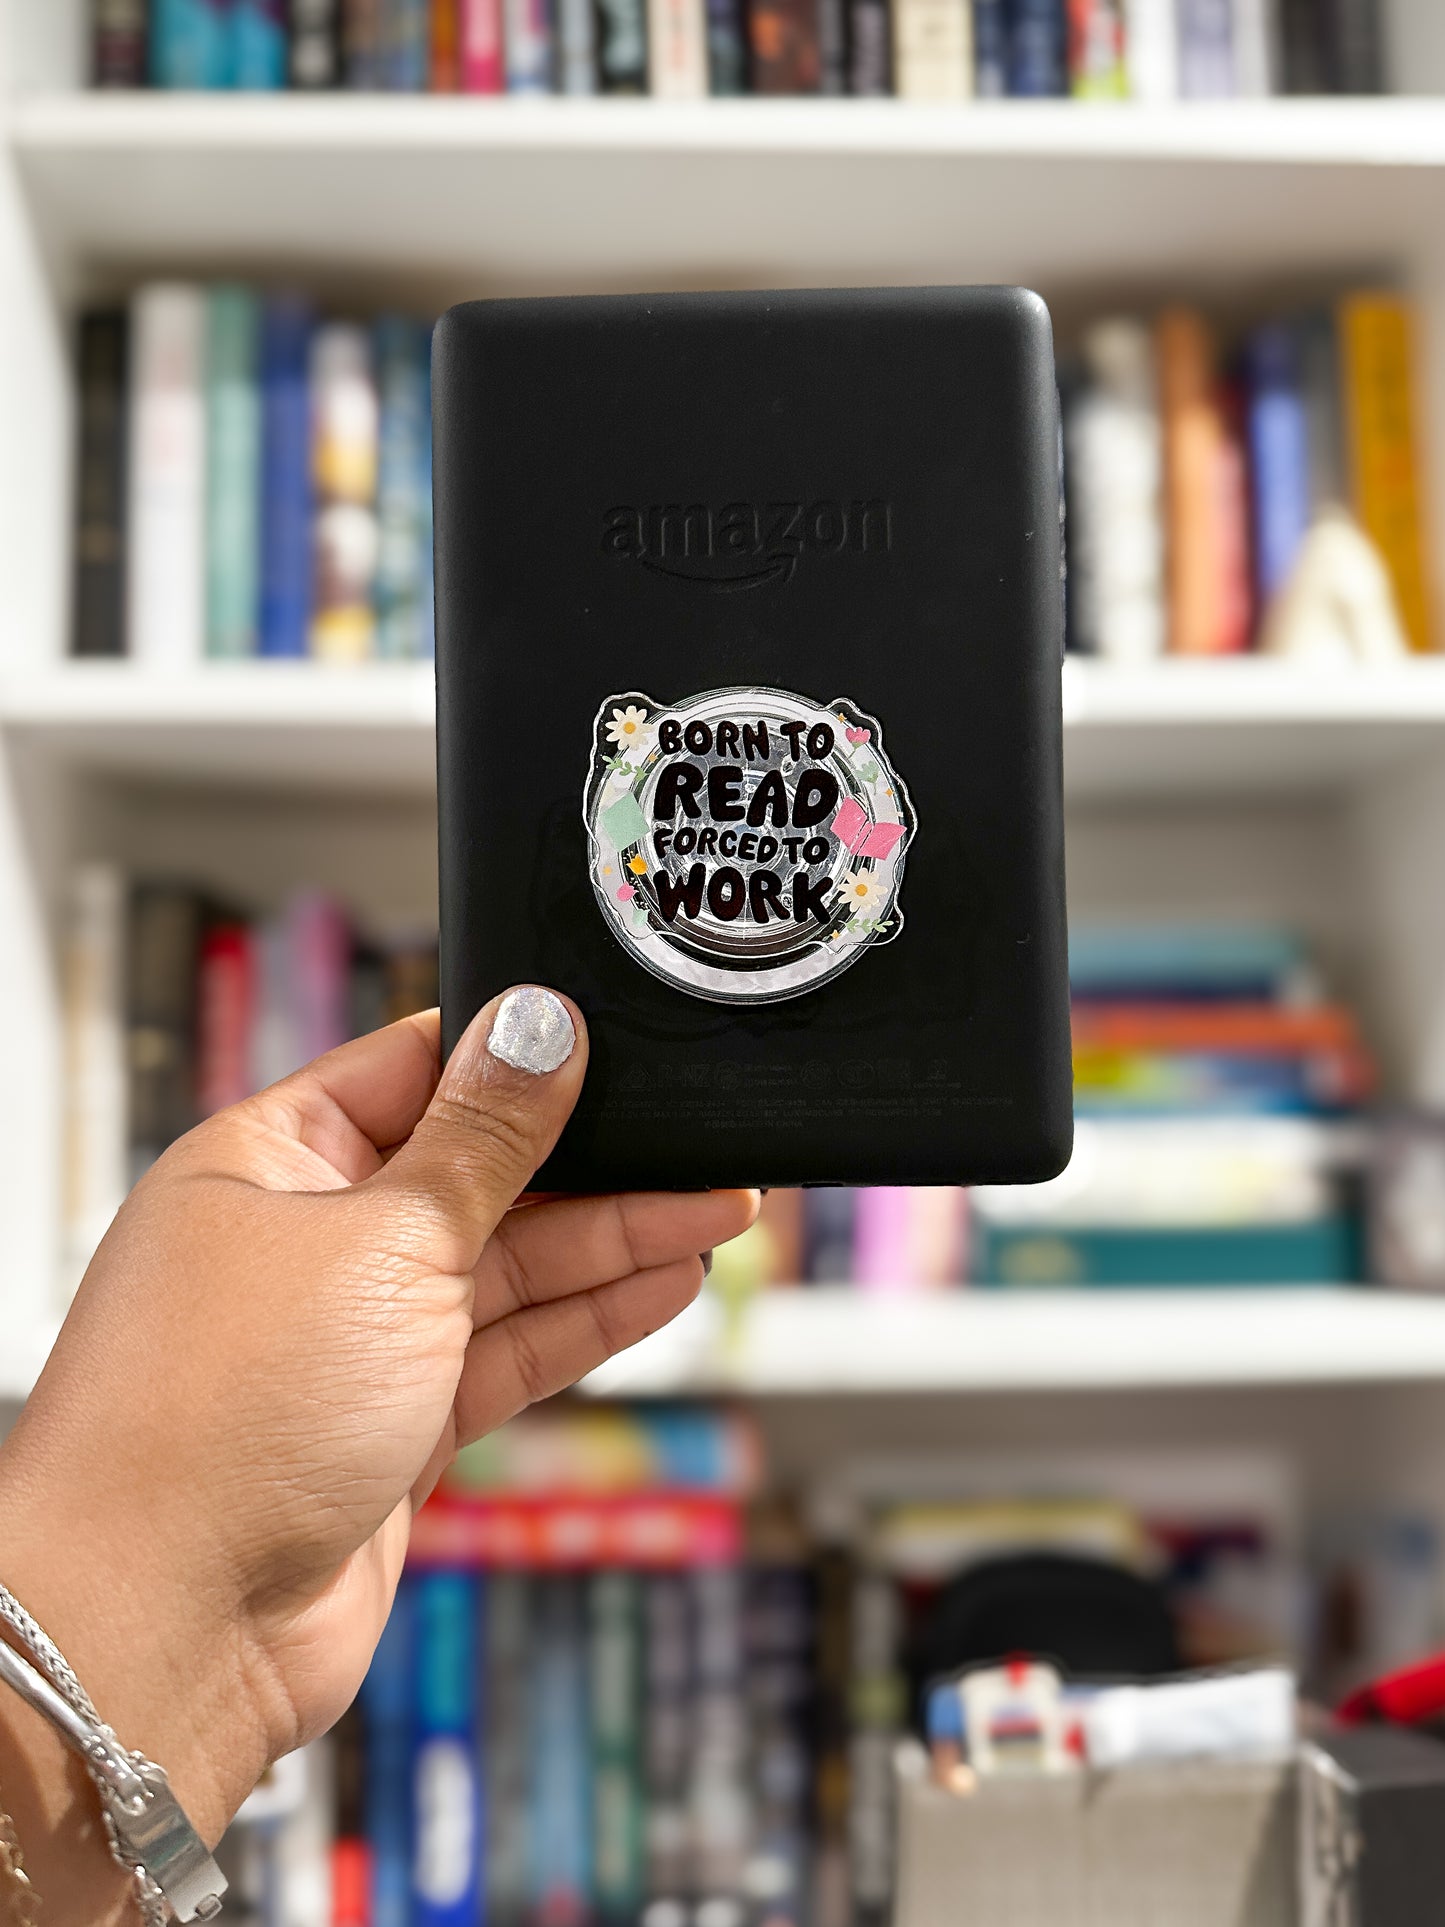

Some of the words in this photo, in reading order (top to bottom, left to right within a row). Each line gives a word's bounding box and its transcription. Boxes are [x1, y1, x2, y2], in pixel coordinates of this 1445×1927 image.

[602, 502, 892, 557] amazon
[658, 719, 770, 762] BORN
[780, 720, 835, 762] TO
[653, 761, 840, 829] READ
[653, 827, 779, 863] FORCED
[782, 836, 831, 865] TO
[652, 863, 834, 924] WORK
